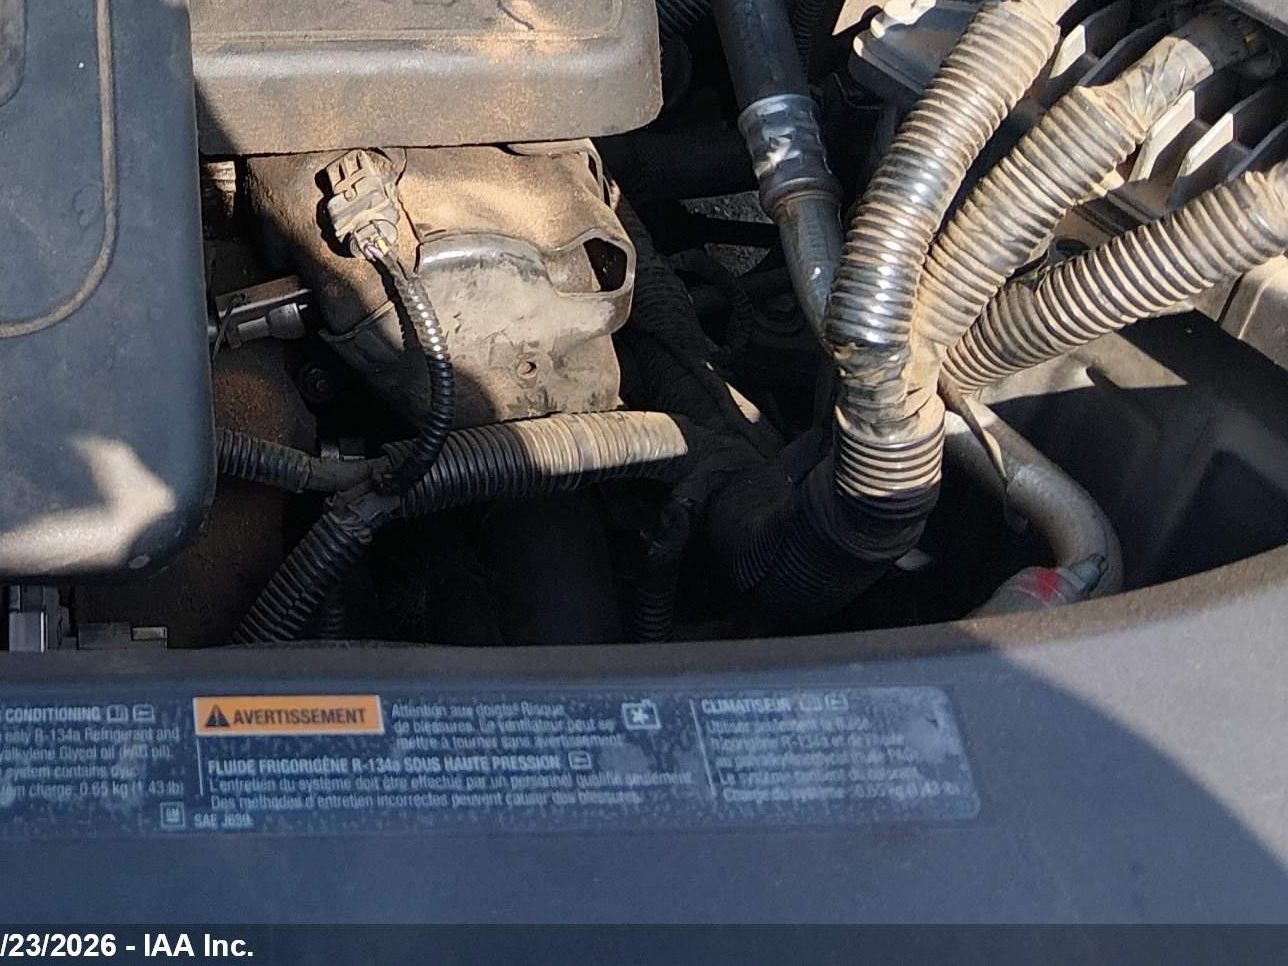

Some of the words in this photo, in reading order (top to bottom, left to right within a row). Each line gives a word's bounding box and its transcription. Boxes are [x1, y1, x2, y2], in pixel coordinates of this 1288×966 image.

[701, 698, 791, 714] CLIMATISEUR
[5, 706, 101, 723] CONDITIONING
[233, 708, 366, 725] AVERTISSEMENT
[84, 726, 153, 743] Refrigerant
[156, 725, 180, 742] and
[54, 764, 108, 779] contains
[208, 758, 256, 775] FLUIDE
[352, 756, 401, 773] R-134a
[404, 756, 442, 773] SOUS
[444, 755, 489, 772] HAUTE
[492, 754, 561, 771] PRESSION
[112, 779, 128, 799] kg
[279, 776, 295, 791] du
[210, 794, 235, 810] Des
[194, 813, 217, 828] SAE
